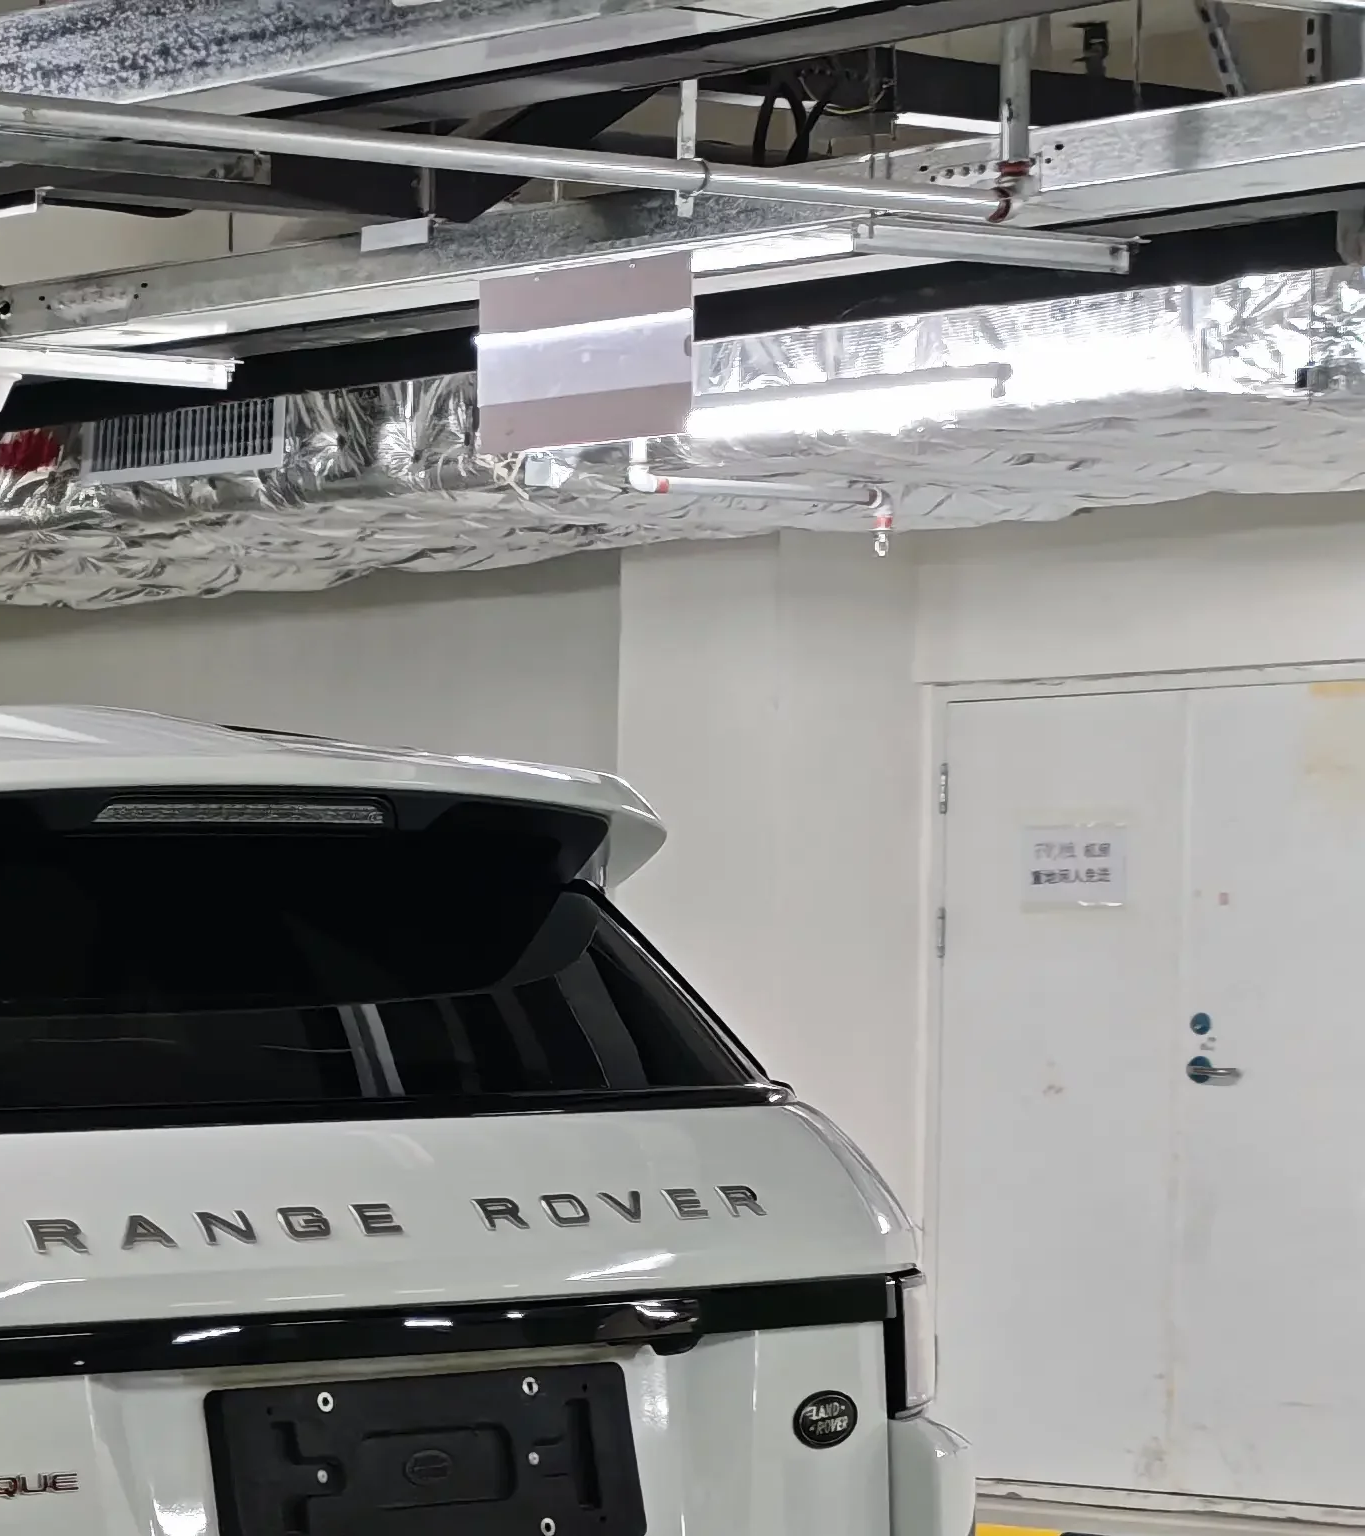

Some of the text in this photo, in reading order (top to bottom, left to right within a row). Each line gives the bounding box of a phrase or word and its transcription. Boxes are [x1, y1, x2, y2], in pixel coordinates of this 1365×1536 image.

[23, 1184, 769, 1256] RANGE ROVER
[809, 1401, 841, 1421] LAND
[815, 1415, 850, 1436] ROVER
